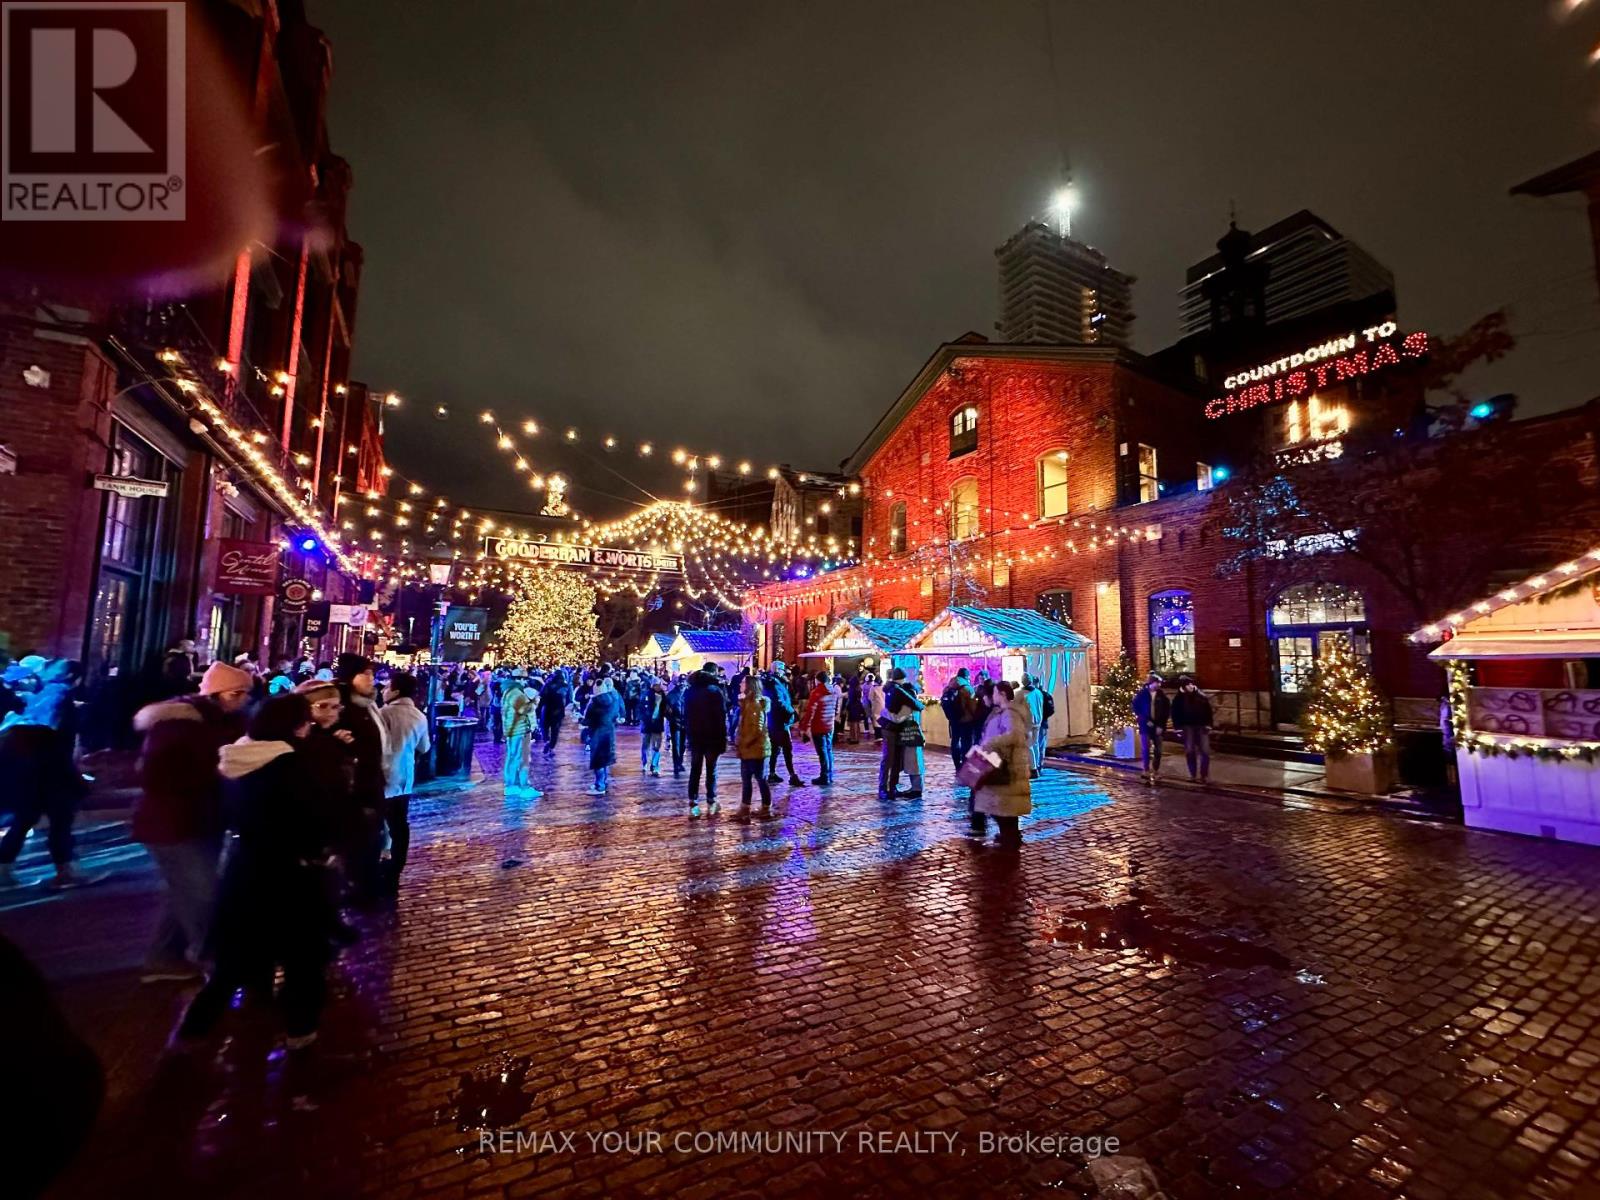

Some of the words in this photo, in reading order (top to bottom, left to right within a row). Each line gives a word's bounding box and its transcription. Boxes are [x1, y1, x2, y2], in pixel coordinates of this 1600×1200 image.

[1224, 334, 1356, 389] COUNTDOWN
[1363, 321, 1397, 342] TO
[1204, 330, 1429, 420] CHRISTMAS
[102, 482, 128, 491] TANK
[129, 486, 161, 495] HOUSE
[495, 540, 590, 563] GOODERHAM
[593, 550, 605, 564] &
[606, 552, 653, 568] WORTS
[449, 631, 473, 640] WORTH
[474, 632, 481, 641] IT
[453, 622, 478, 631] YOU'RE
